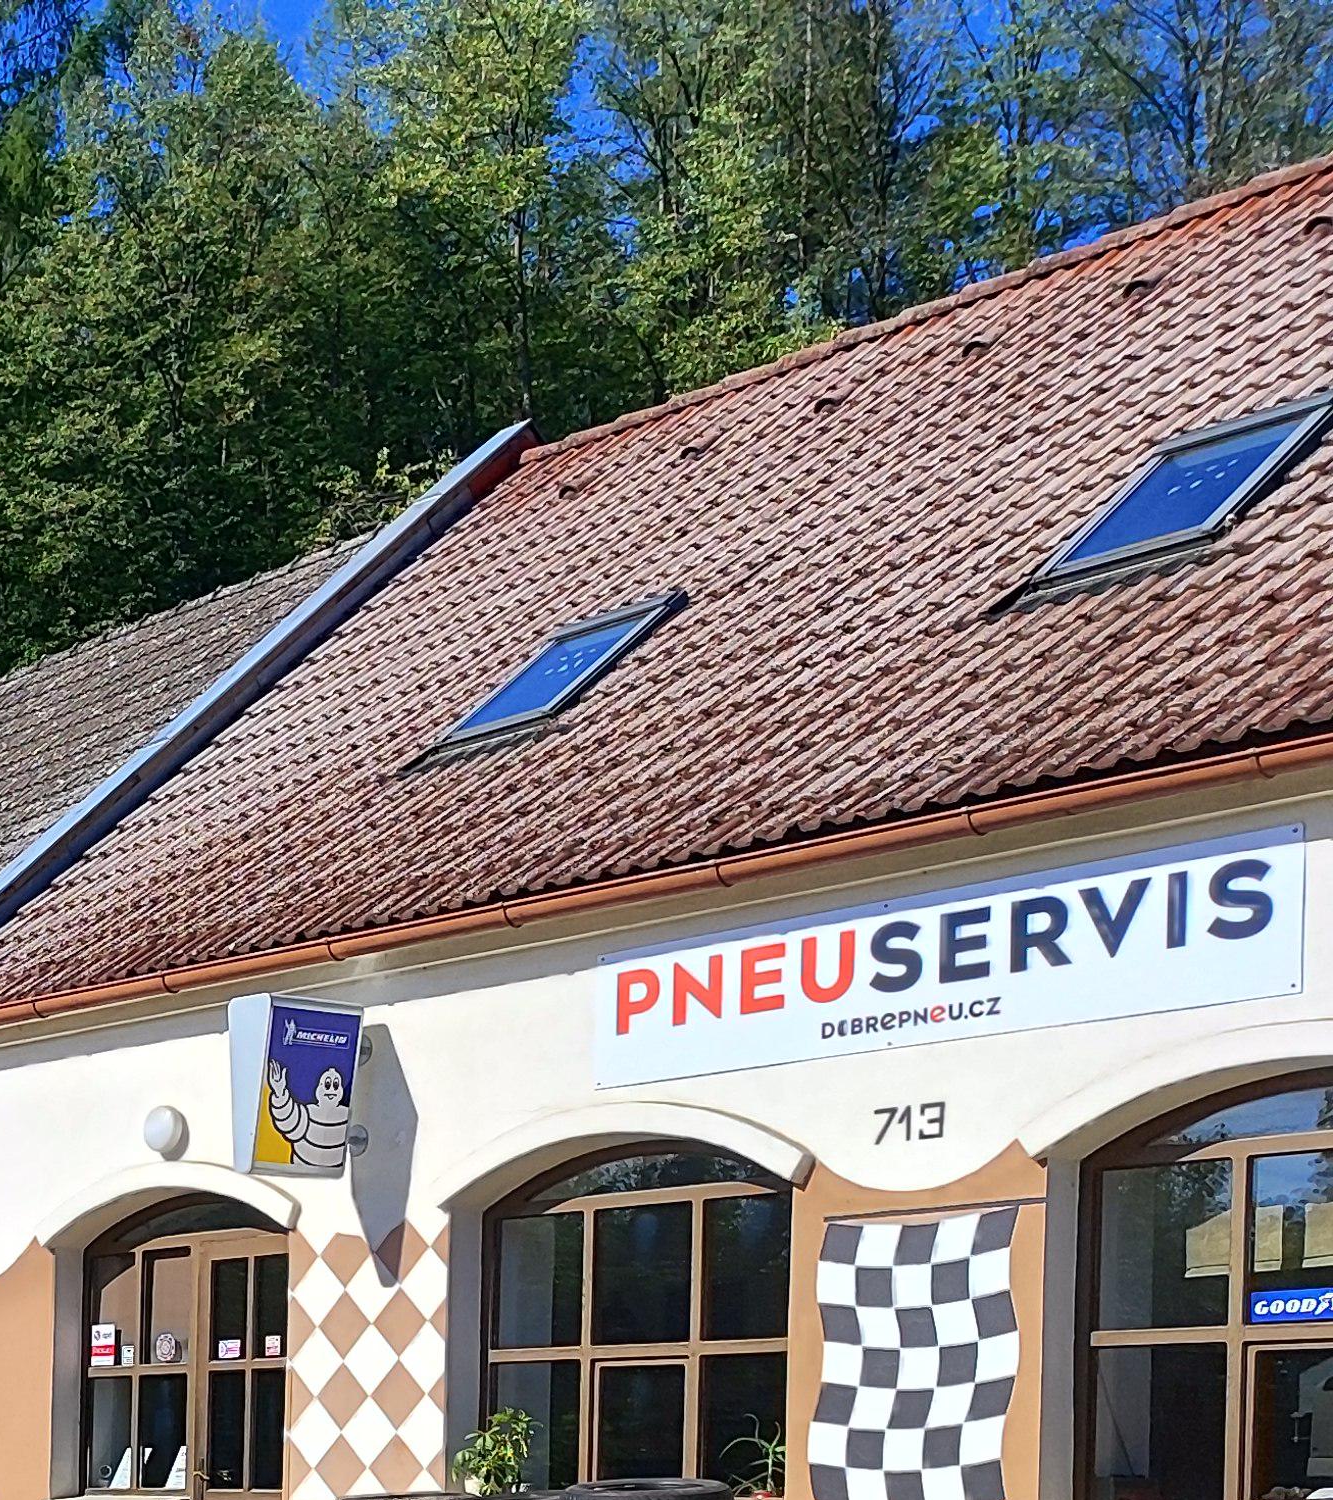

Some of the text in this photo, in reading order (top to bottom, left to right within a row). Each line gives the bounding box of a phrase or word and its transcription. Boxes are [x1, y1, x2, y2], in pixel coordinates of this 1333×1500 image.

[615, 858, 1275, 1037] PNEUSERVIS
[296, 1031, 348, 1044] MICHELIN
[873, 1101, 946, 1146] 713
[1254, 1297, 1333, 1316] GOOD
